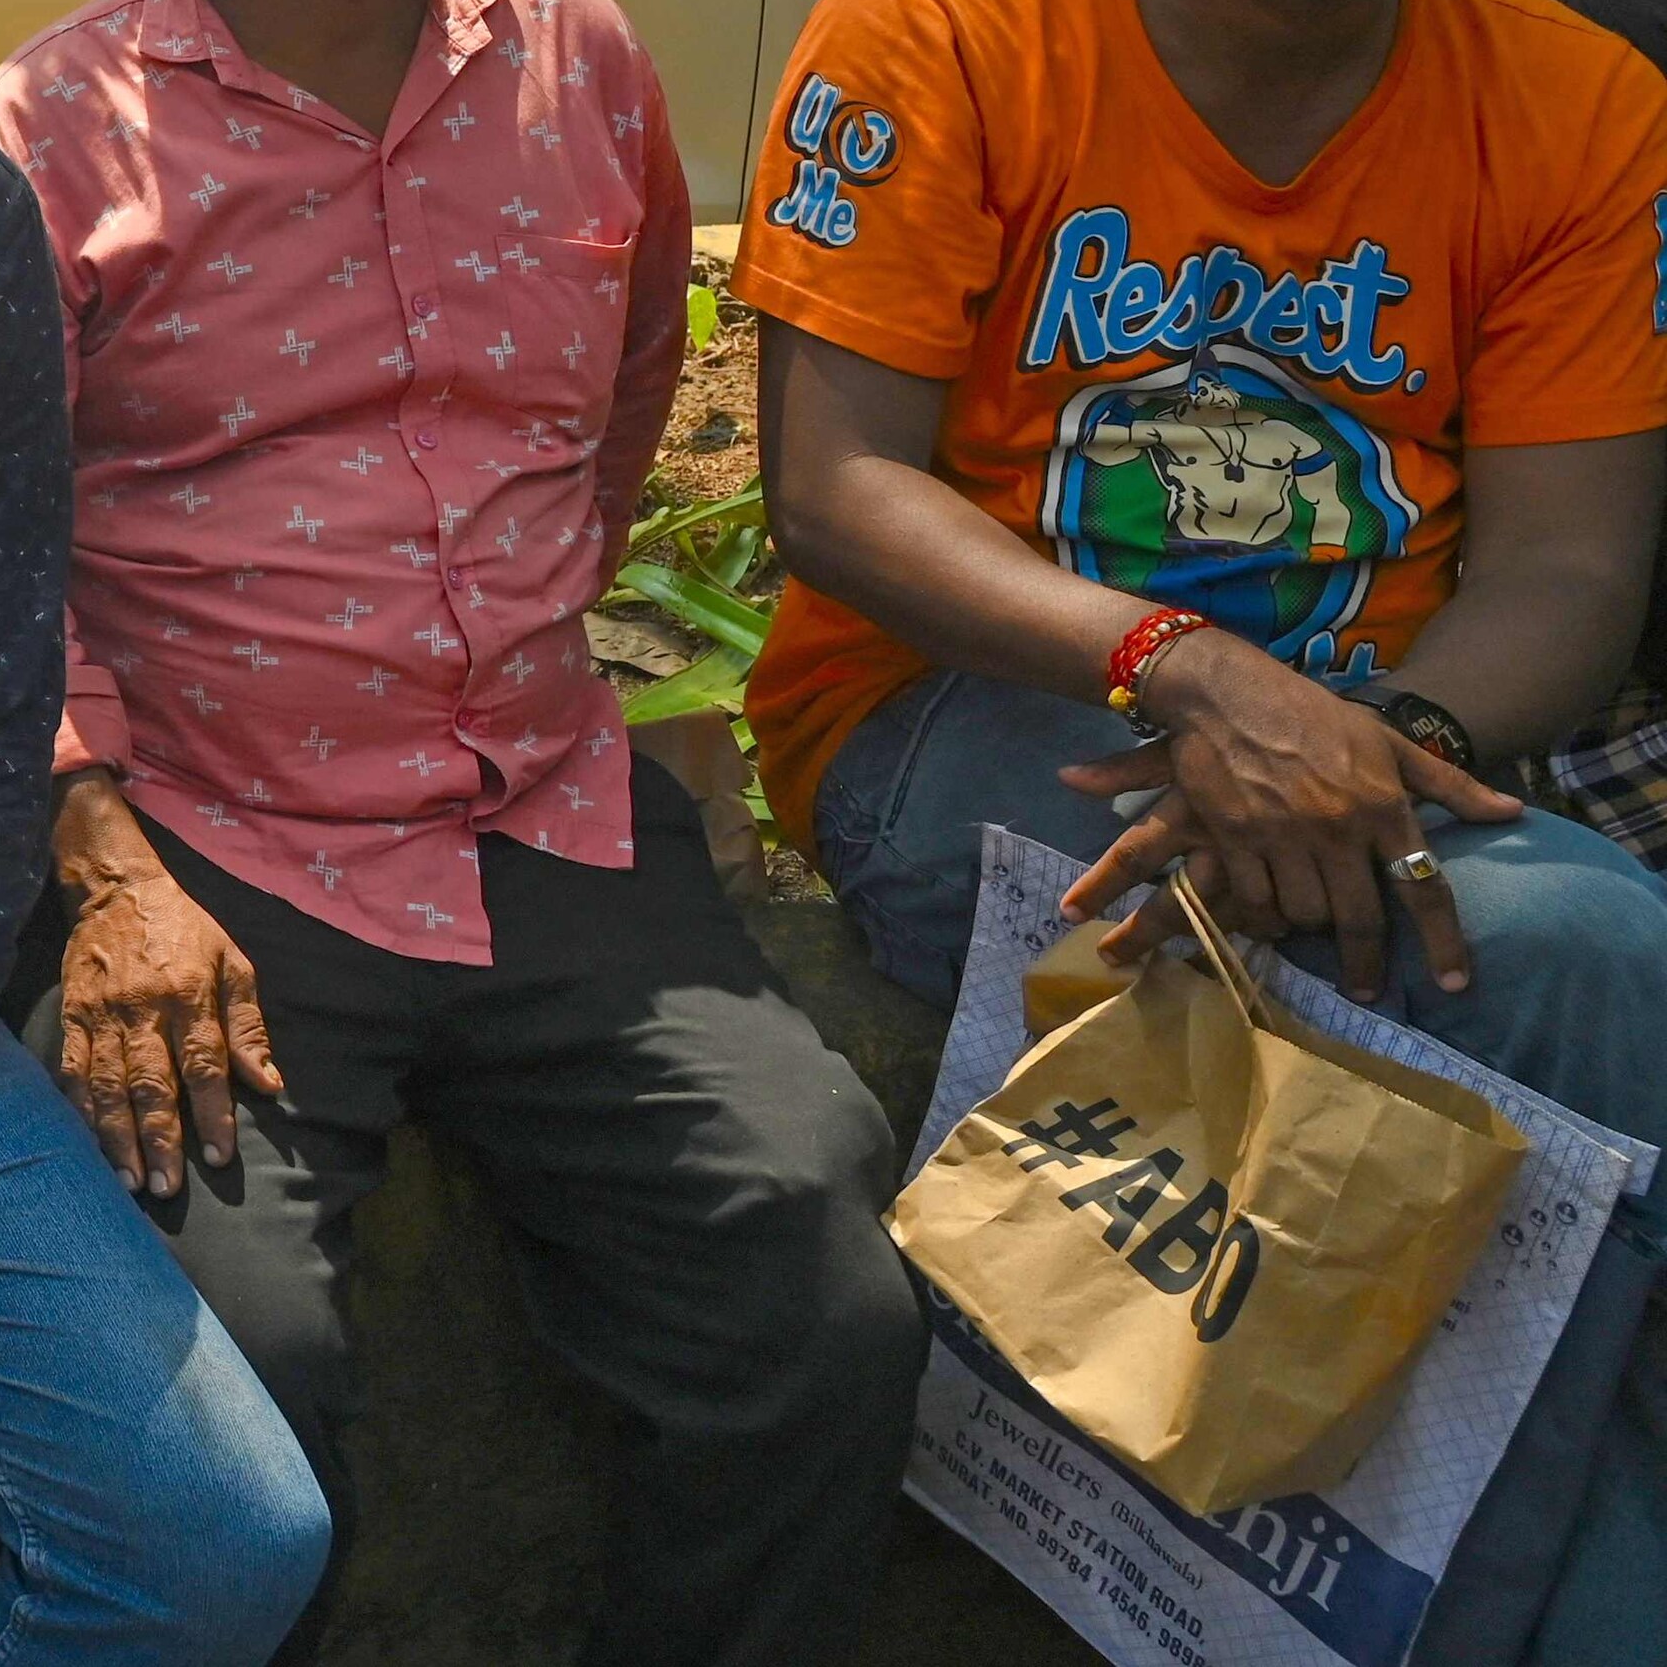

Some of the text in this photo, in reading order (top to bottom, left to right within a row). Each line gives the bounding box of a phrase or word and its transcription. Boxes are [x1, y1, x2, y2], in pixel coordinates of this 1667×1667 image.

[774, 159, 857, 247] Me
[968, 1388, 1103, 1500] Jewellers
[989, 1457, 1066, 1526] MARKET
[1068, 1519, 1149, 1594] STATION
[1149, 1585, 1206, 1646] ROAD,
[1036, 1528, 1094, 1583] 99784
